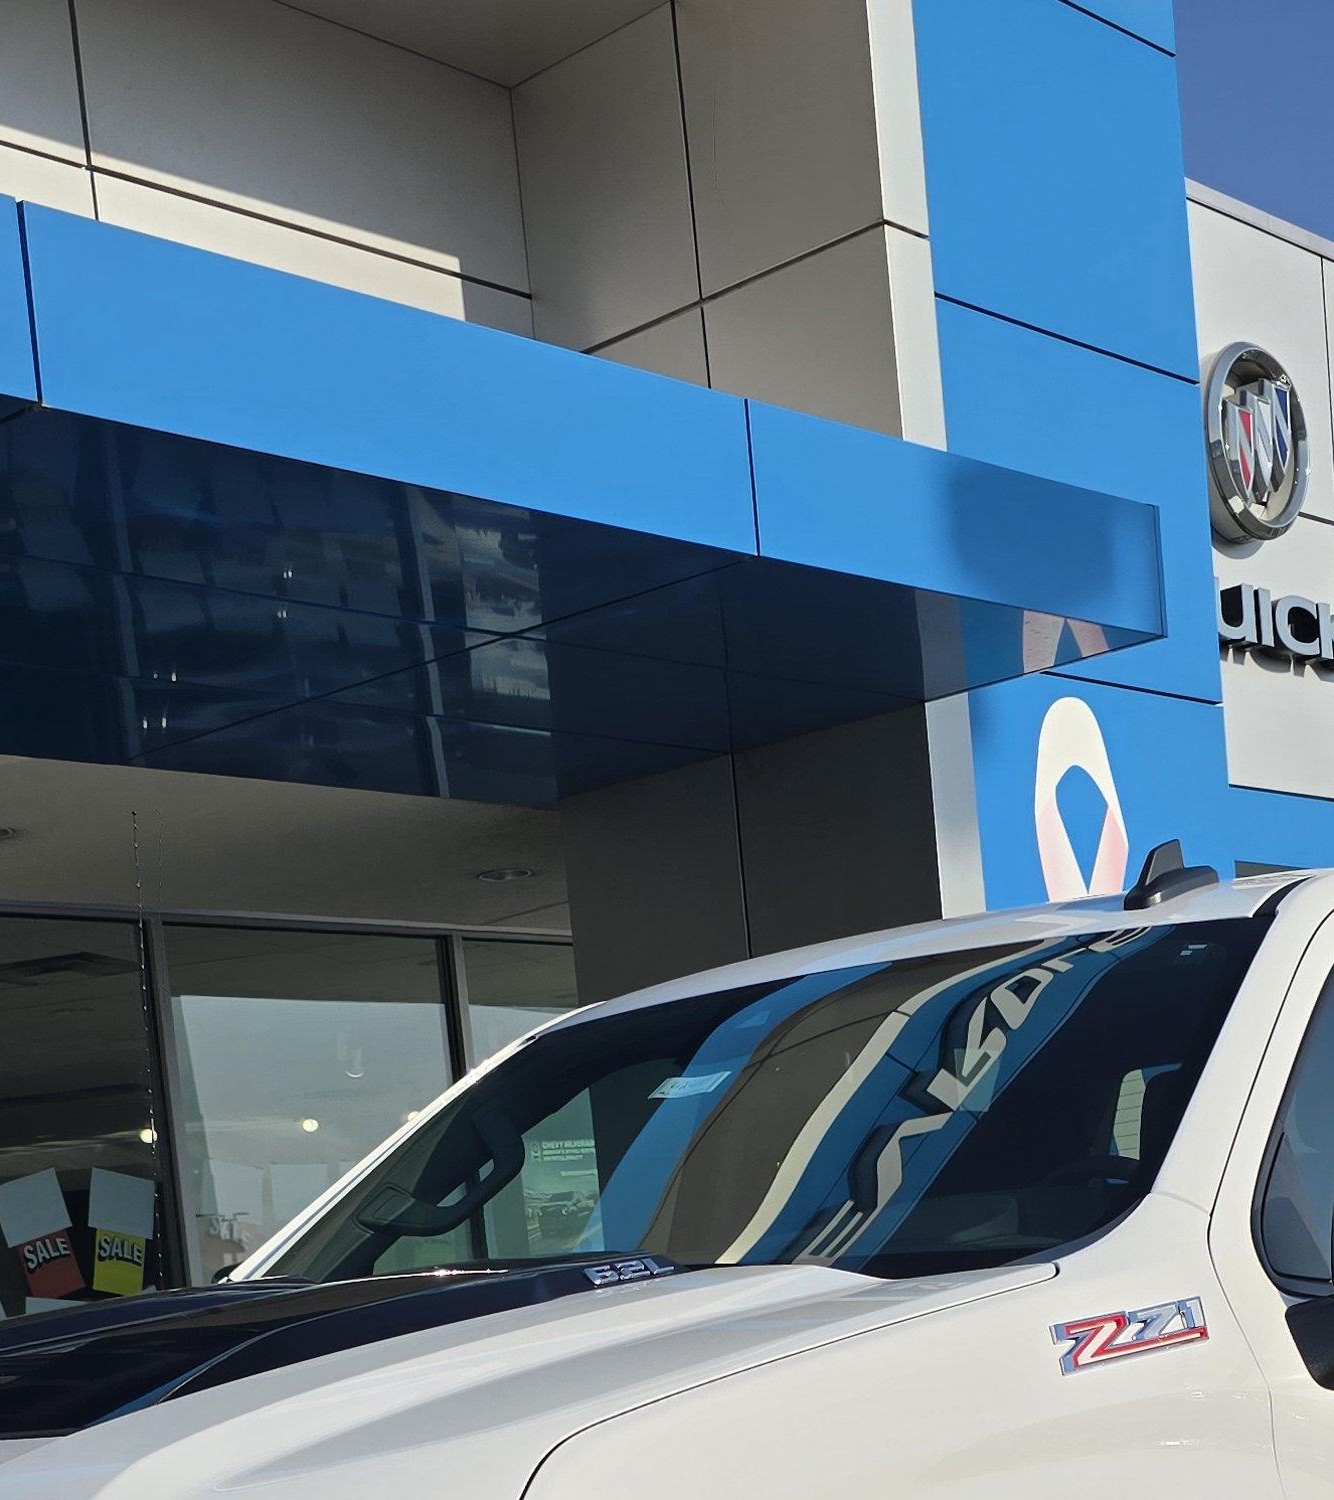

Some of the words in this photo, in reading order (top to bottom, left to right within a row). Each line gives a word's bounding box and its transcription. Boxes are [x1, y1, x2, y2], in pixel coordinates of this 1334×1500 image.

[23, 1237, 71, 1270] SALE
[99, 1235, 143, 1265] SALE
[1049, 1296, 1209, 1376] Z71
